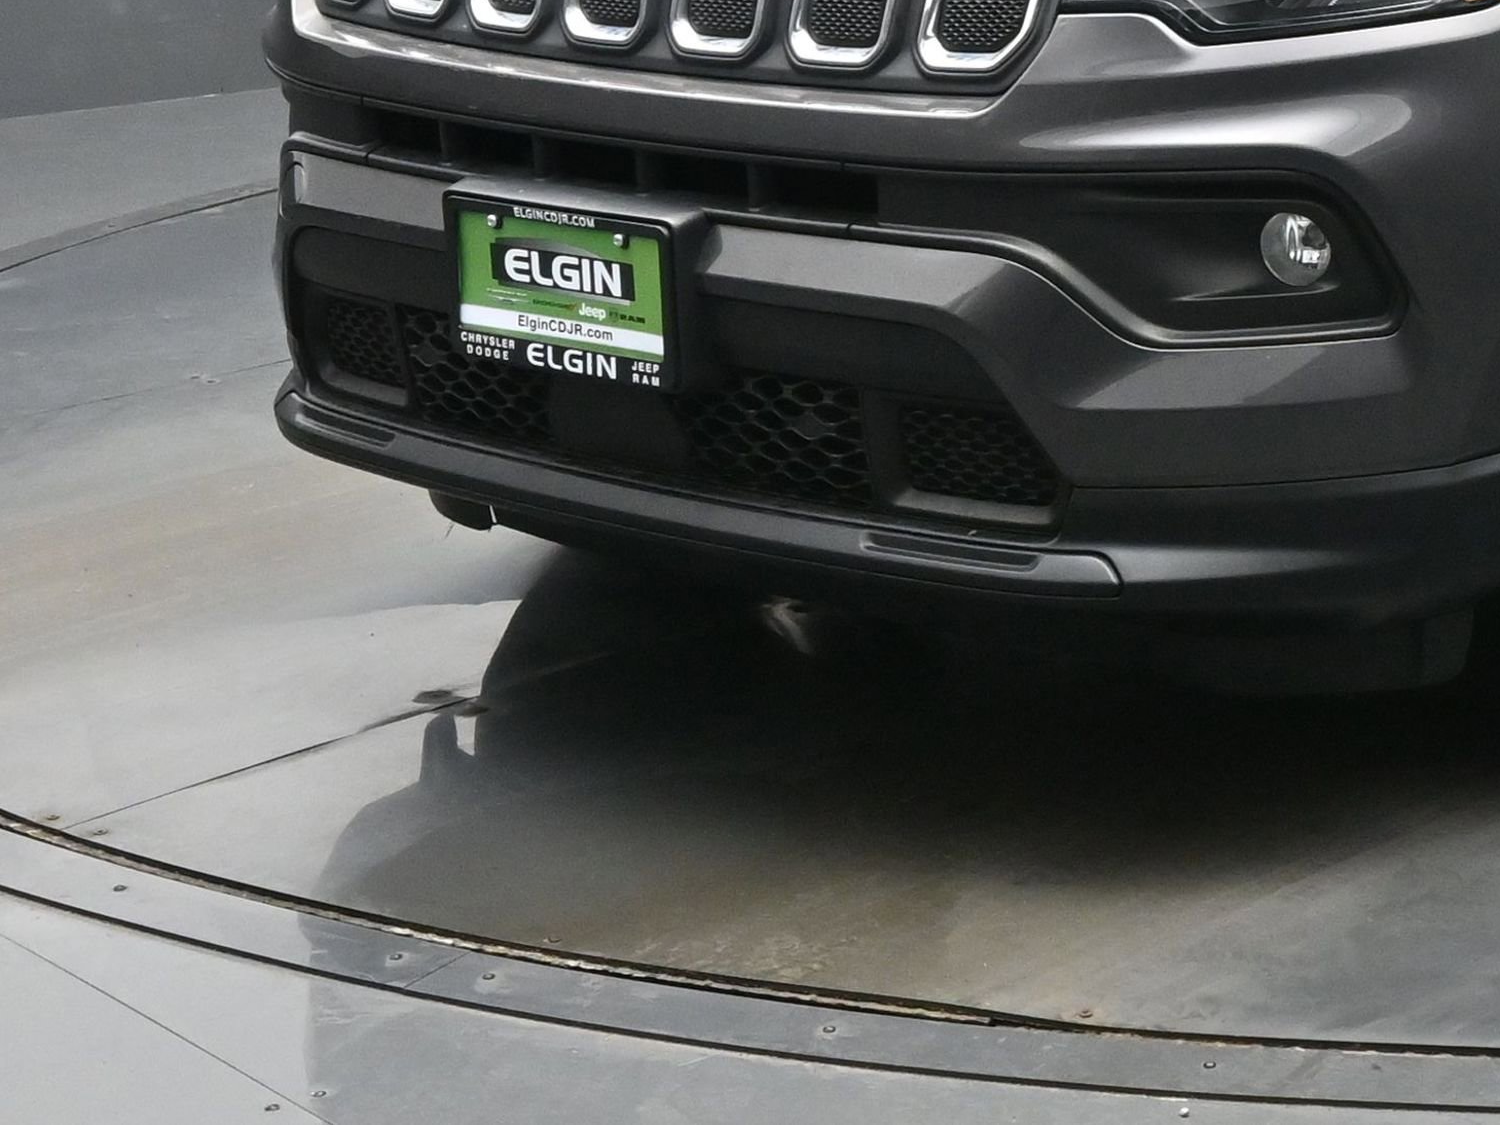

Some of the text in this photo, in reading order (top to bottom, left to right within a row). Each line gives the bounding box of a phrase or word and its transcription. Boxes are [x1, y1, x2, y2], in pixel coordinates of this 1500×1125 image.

[513, 207, 595, 228] ELGINCDJR.COM
[504, 248, 622, 297] ELGIN
[578, 303, 606, 321] Jeep
[517, 314, 613, 341] ElginCDJR.com
[461, 331, 515, 350] CHRYSLER
[467, 346, 510, 361] DODGE
[526, 342, 617, 380] ELGIN
[631, 361, 660, 373] JEEP
[632, 373, 660, 387] RAM
